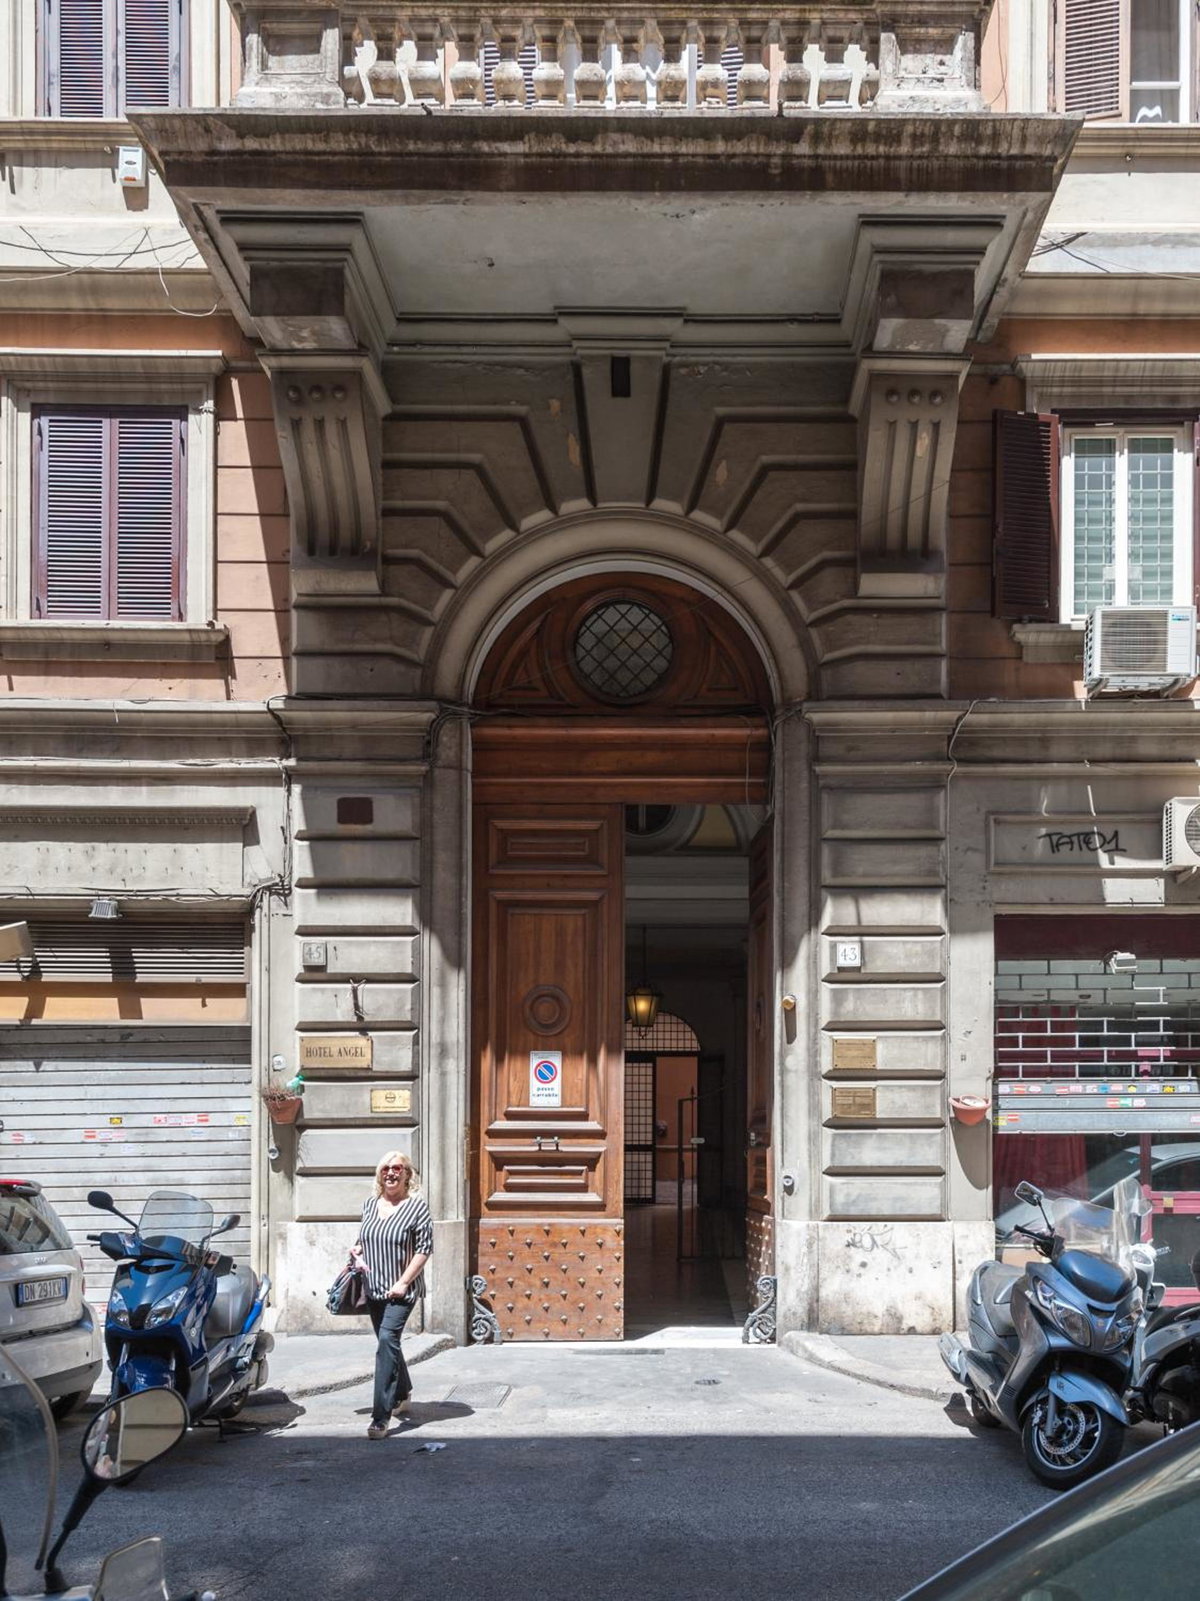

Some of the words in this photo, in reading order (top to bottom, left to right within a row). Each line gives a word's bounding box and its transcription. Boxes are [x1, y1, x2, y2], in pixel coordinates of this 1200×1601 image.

[305, 946, 322, 959] 45
[840, 947, 857, 961] 43
[305, 1046, 334, 1058] HOTEL
[337, 1046, 366, 1058] ANGEL
[24, 1284, 36, 1301] DN
